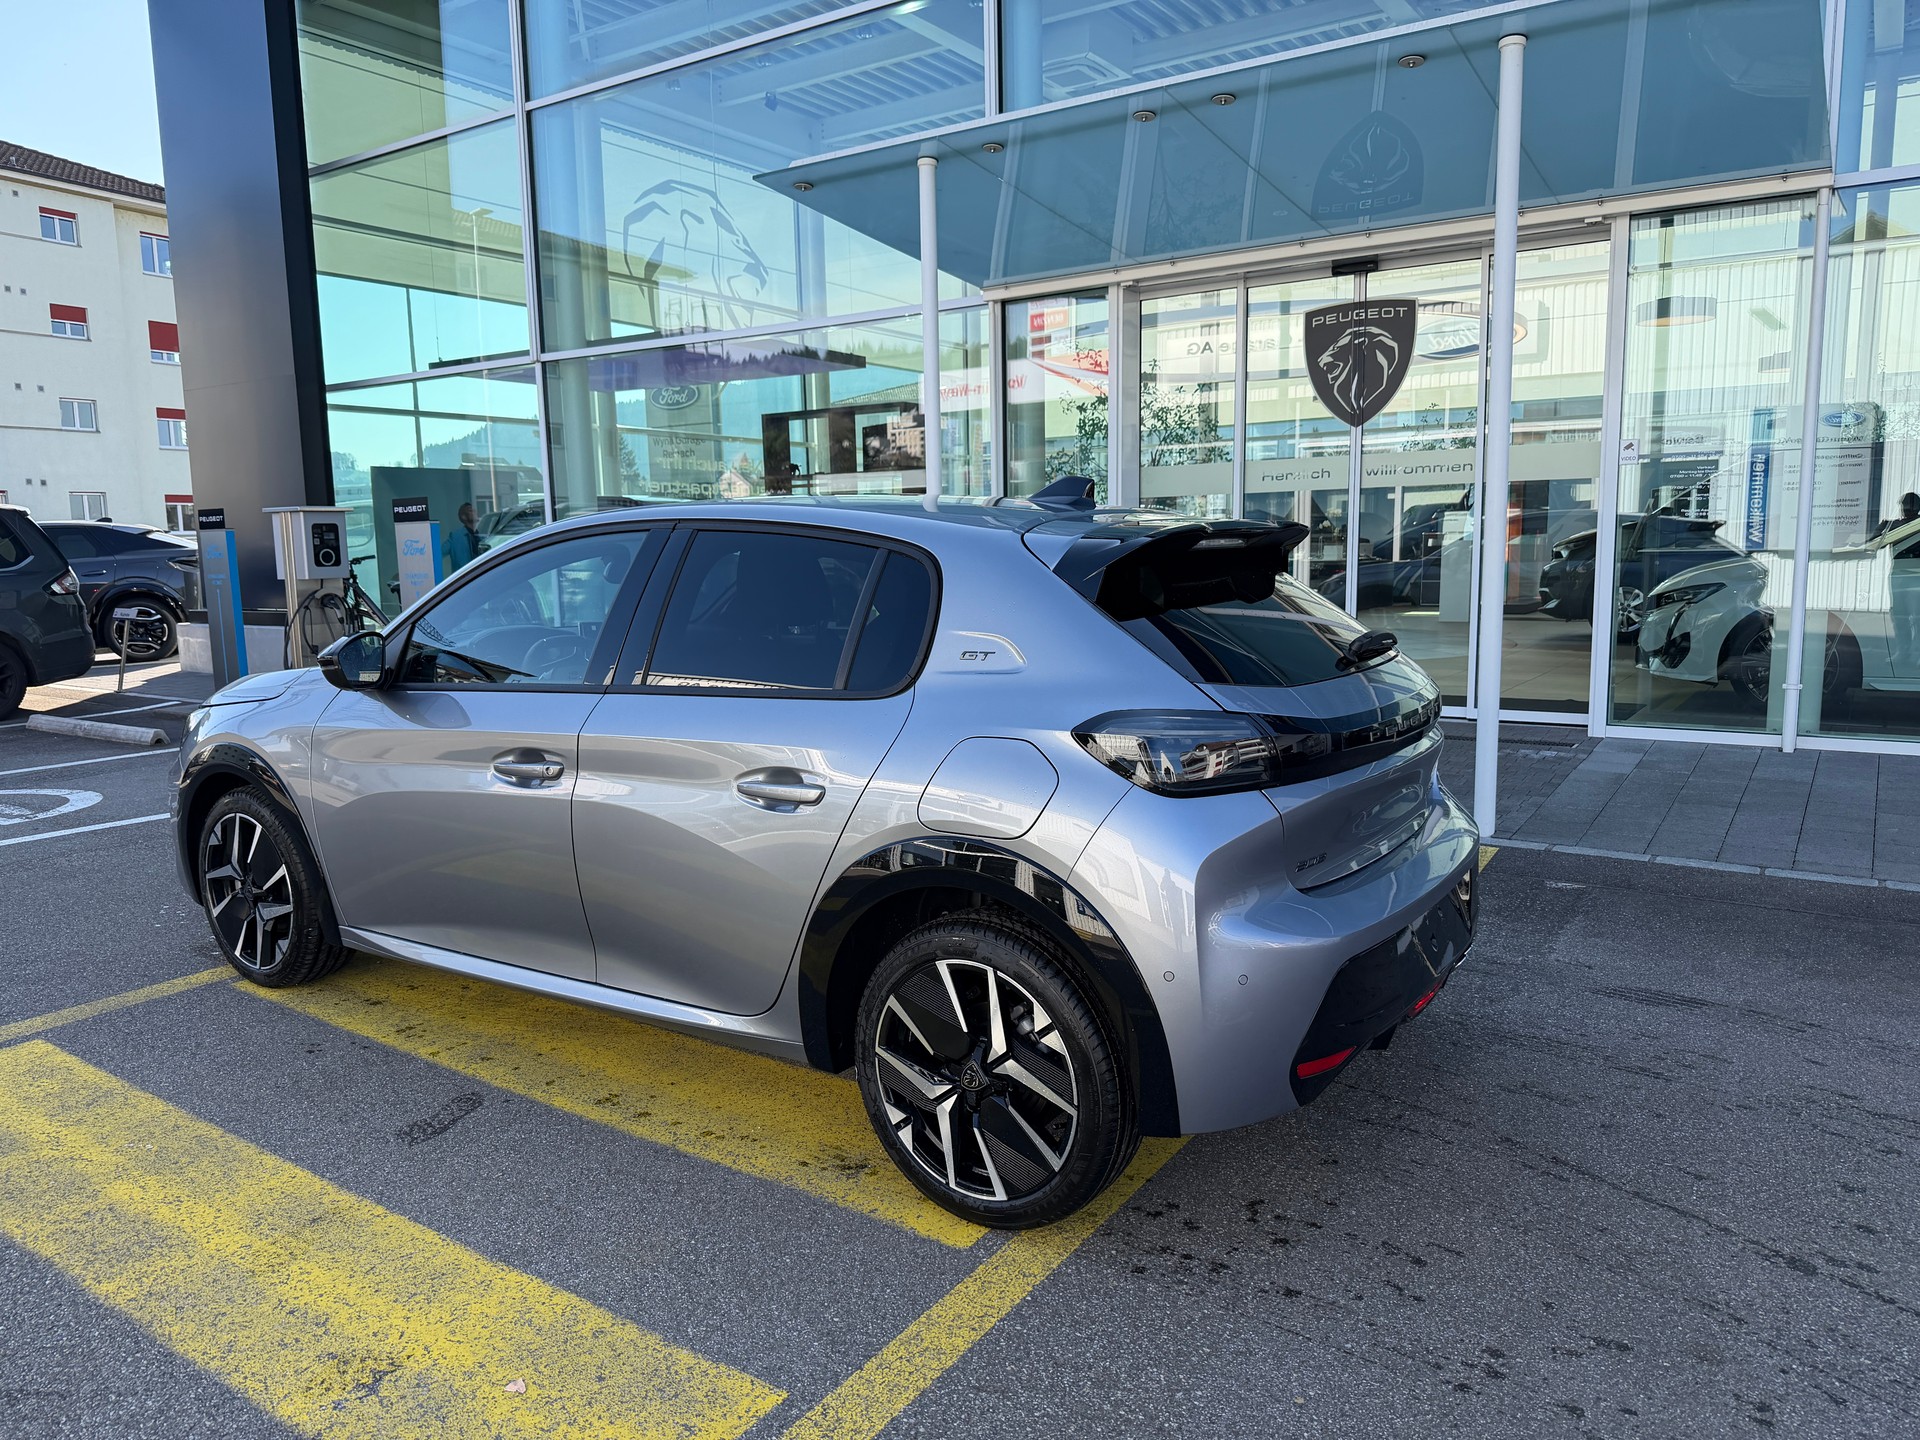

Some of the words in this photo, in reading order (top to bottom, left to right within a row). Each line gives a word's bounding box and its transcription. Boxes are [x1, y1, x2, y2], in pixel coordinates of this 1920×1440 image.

[1312, 307, 1408, 328] PEUGEOT
[658, 385, 690, 404] Ford
[394, 505, 427, 513] PEUGEOT
[960, 650, 996, 661] GT
[1369, 701, 1439, 742] PEUGEOT
